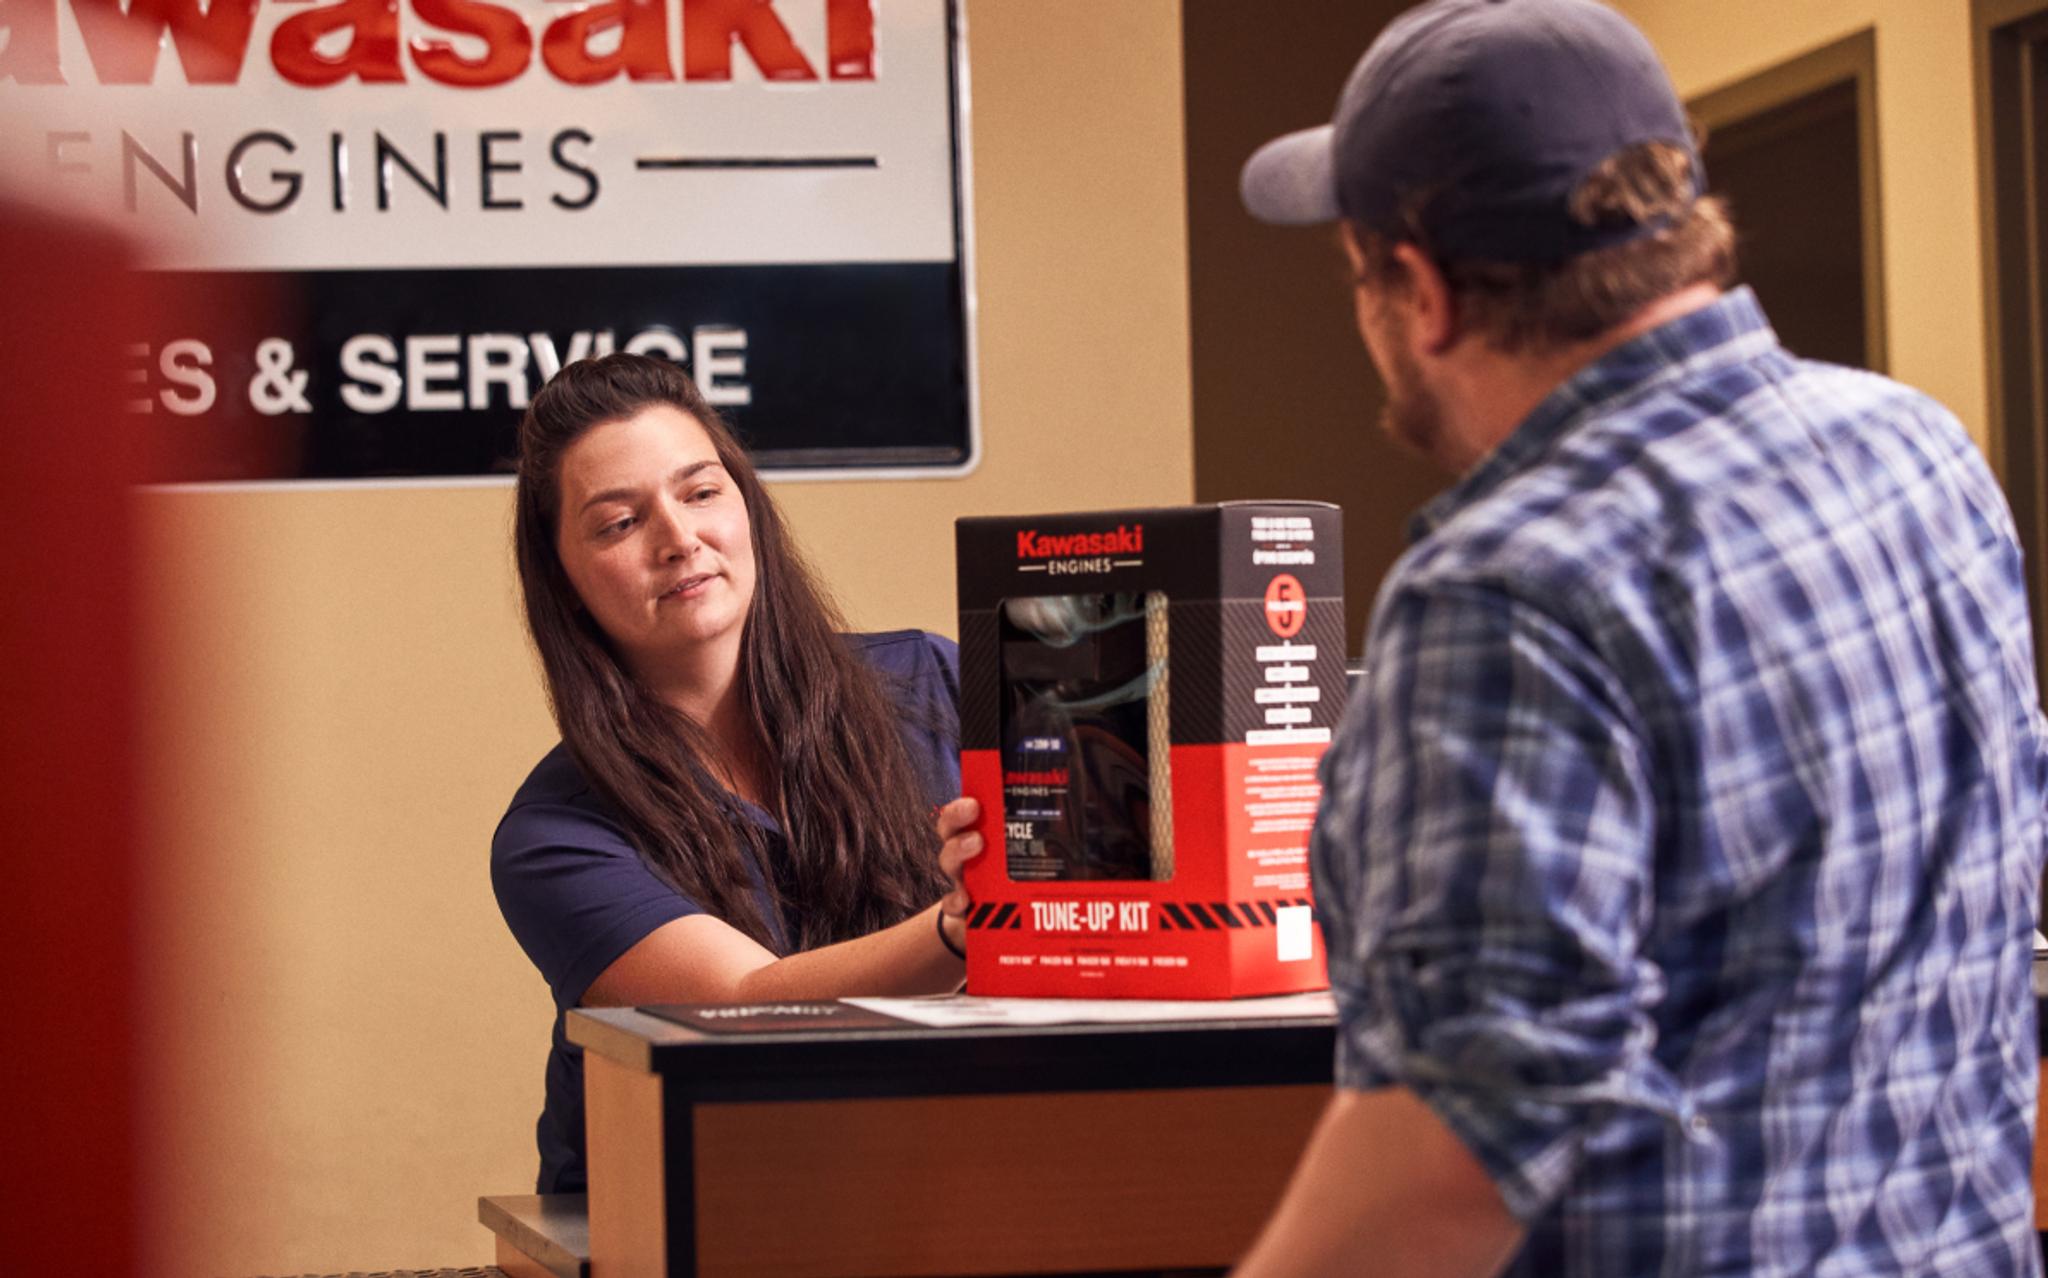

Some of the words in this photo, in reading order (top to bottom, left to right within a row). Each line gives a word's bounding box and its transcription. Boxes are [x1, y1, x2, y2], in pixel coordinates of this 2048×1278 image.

[46, 128, 601, 216] ENGINES
[250, 338, 312, 415] &
[340, 327, 750, 413] SERVE
[1017, 525, 1143, 558] Kawasaki
[1048, 558, 1111, 575] ENGINES
[1030, 901, 1115, 931] TUNE-UP
[1119, 901, 1151, 931] KIT
